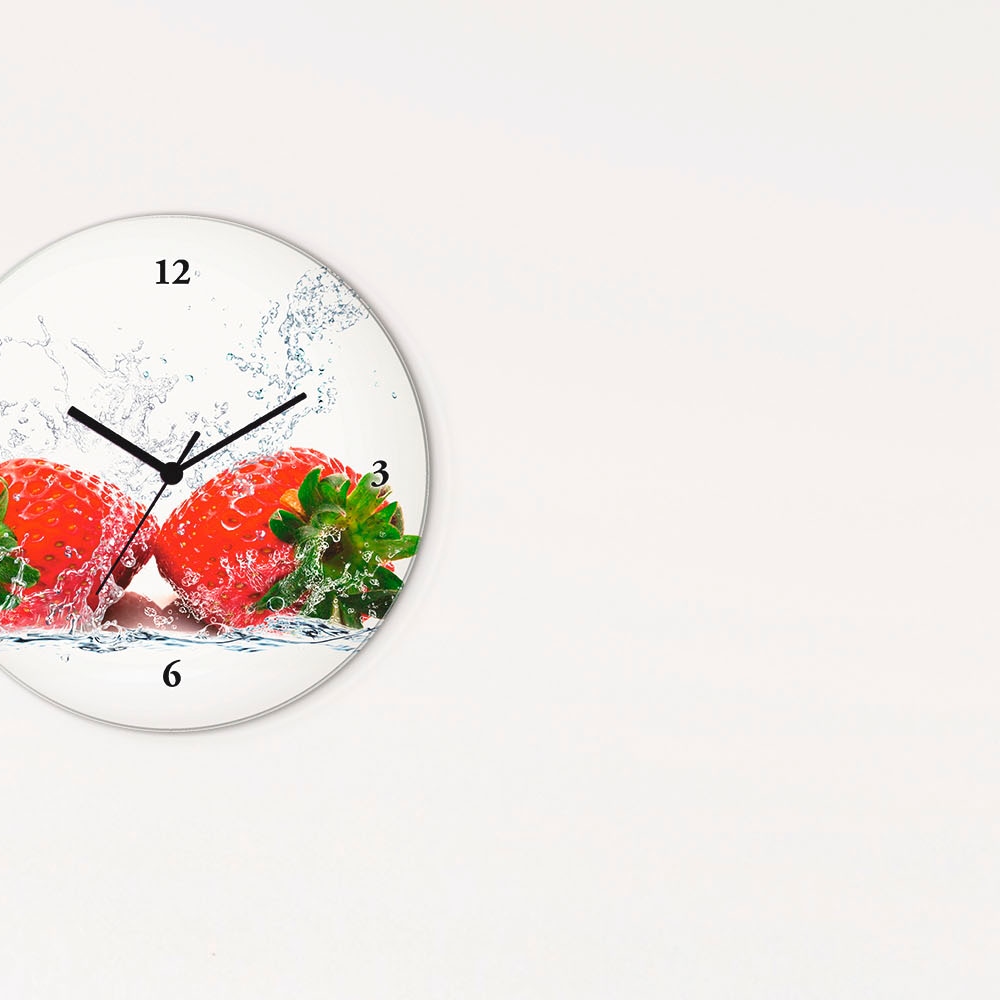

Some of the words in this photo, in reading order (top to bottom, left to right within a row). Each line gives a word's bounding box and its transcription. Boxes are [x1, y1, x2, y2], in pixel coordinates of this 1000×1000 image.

[155, 259, 191, 285] 12
[370, 460, 390, 488] 3
[162, 659, 182, 688] 6
